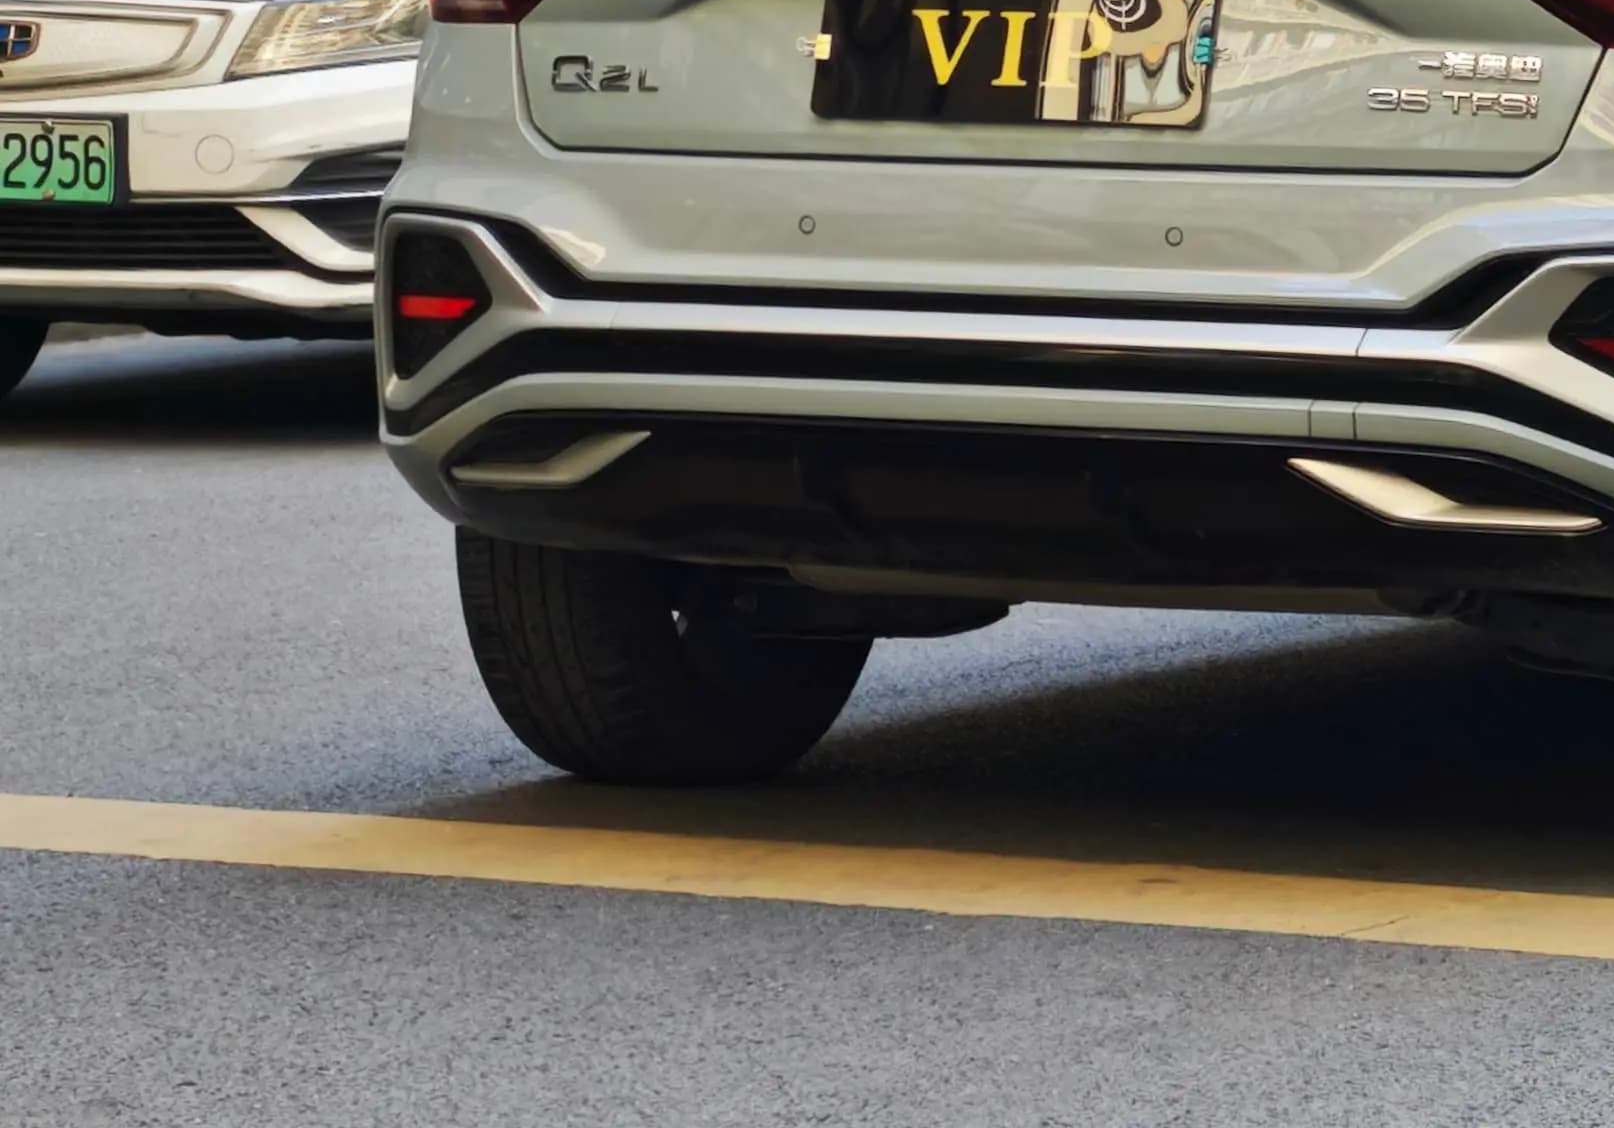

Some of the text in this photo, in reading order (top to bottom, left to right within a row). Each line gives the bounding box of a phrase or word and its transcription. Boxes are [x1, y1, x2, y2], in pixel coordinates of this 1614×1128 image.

[912, 9, 1113, 88] VIP
[1417, 51, 1542, 83] 一汽奥迪
[552, 55, 659, 92] Q2L
[1367, 87, 1431, 113] 35
[3, 132, 107, 191] 2956
